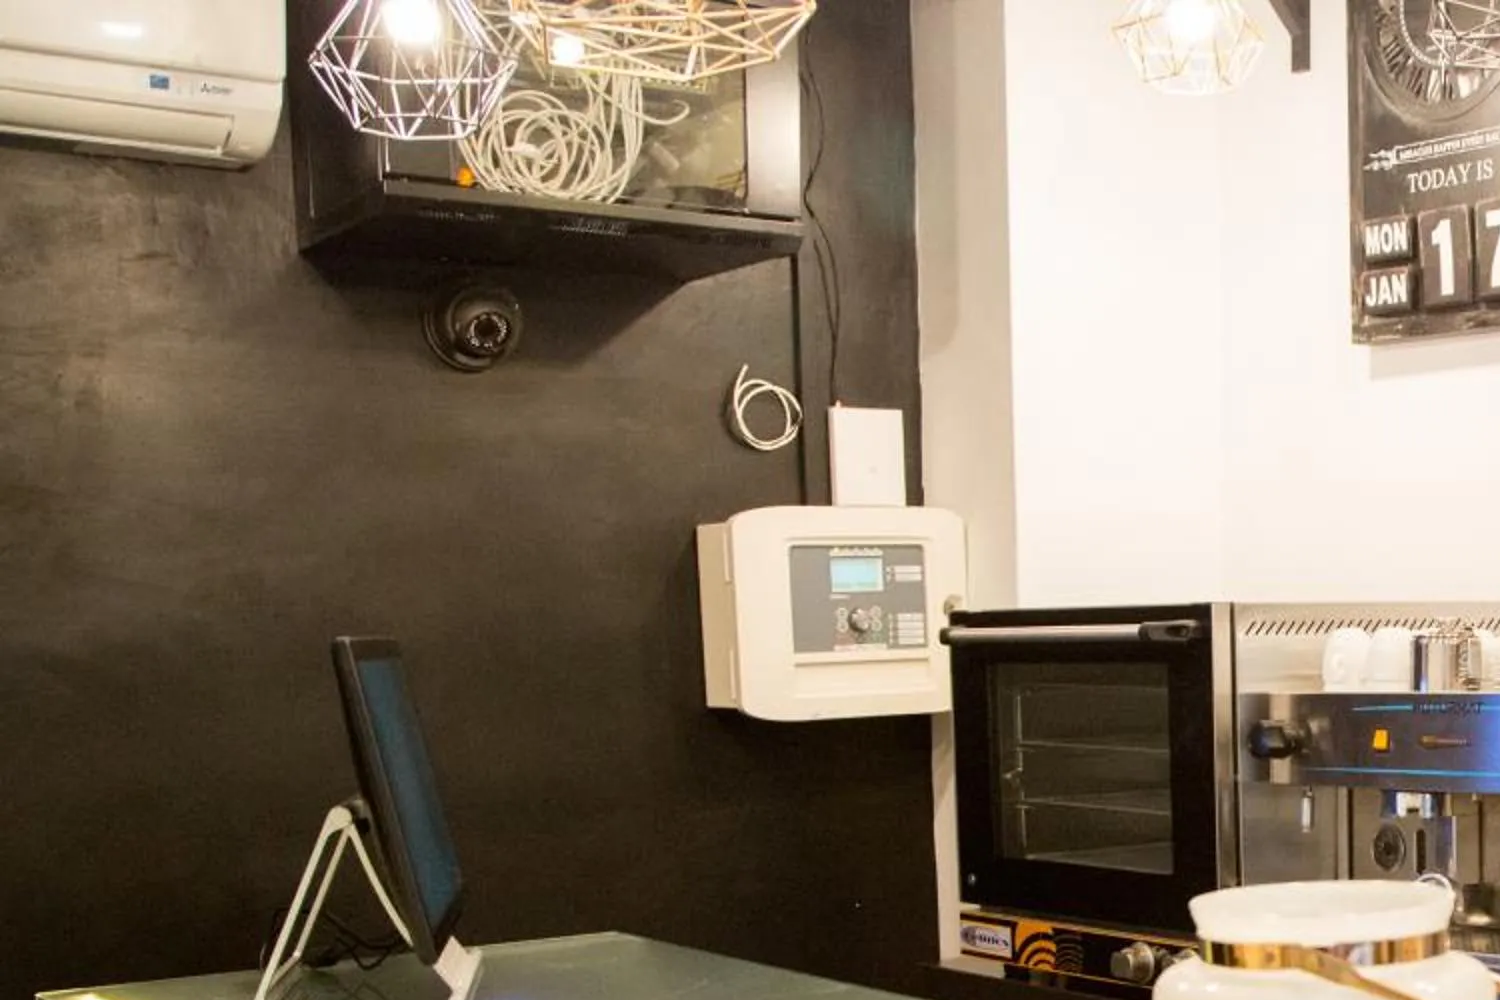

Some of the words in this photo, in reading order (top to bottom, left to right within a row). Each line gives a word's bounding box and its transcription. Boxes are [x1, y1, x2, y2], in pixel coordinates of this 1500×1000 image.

[1408, 162, 1472, 194] TODAY
[1476, 158, 1495, 182] IS
[1365, 221, 1408, 257] MON
[1365, 273, 1408, 307] JAN
